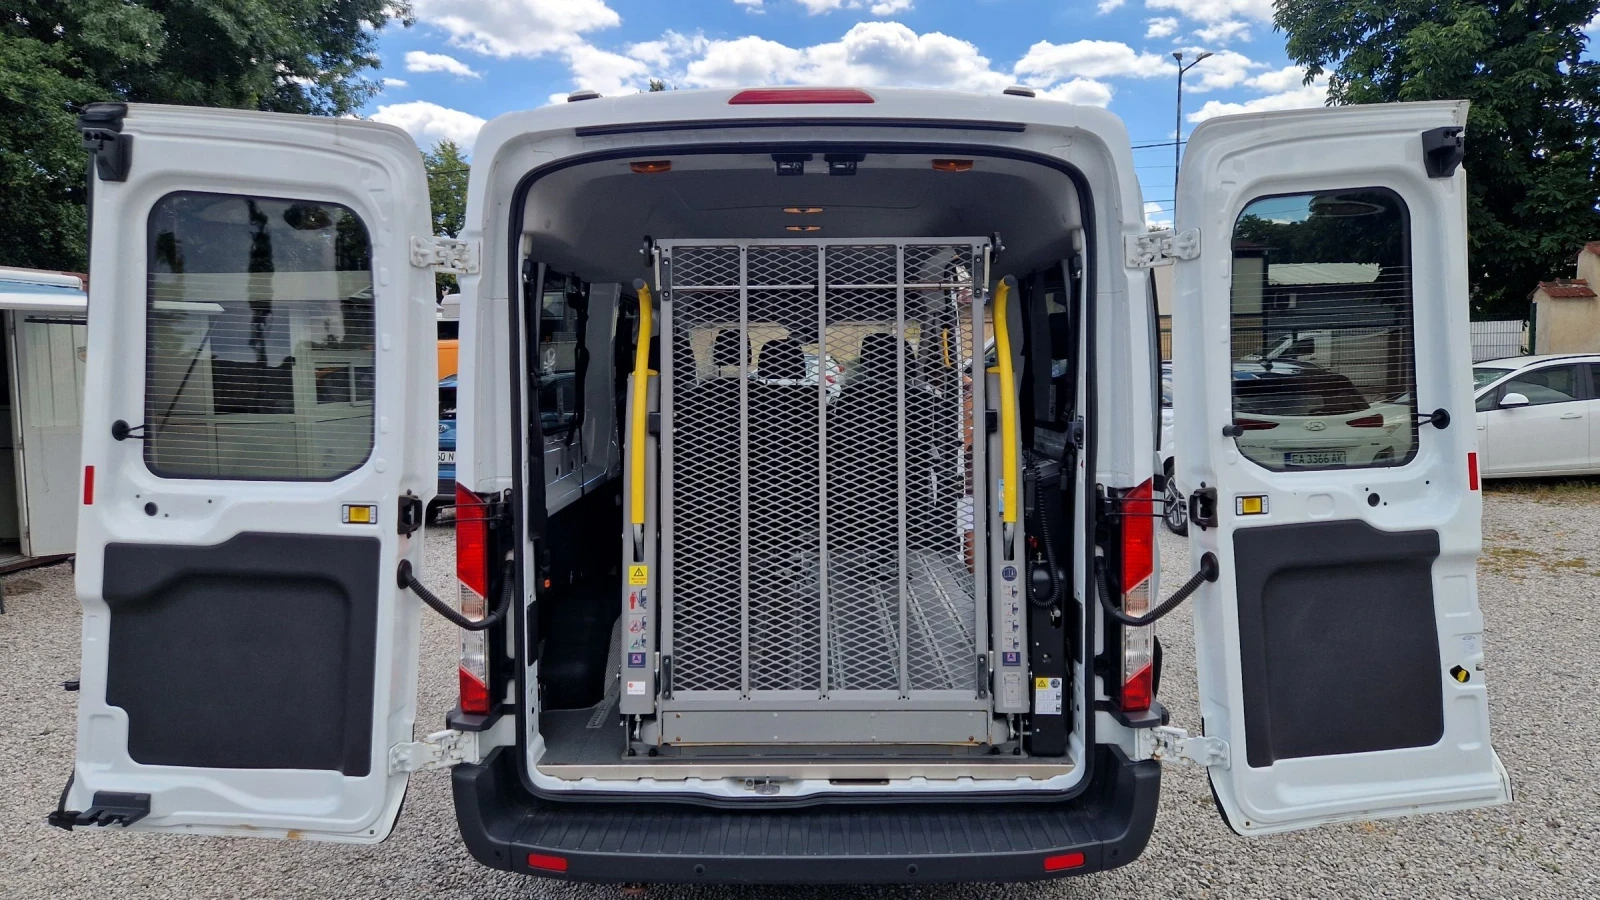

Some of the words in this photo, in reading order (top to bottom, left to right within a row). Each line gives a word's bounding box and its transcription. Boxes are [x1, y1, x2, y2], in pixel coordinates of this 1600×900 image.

[1292, 454, 1304, 464] EA
[1306, 453, 1330, 464] 3366
[1331, 453, 1344, 463] AK
